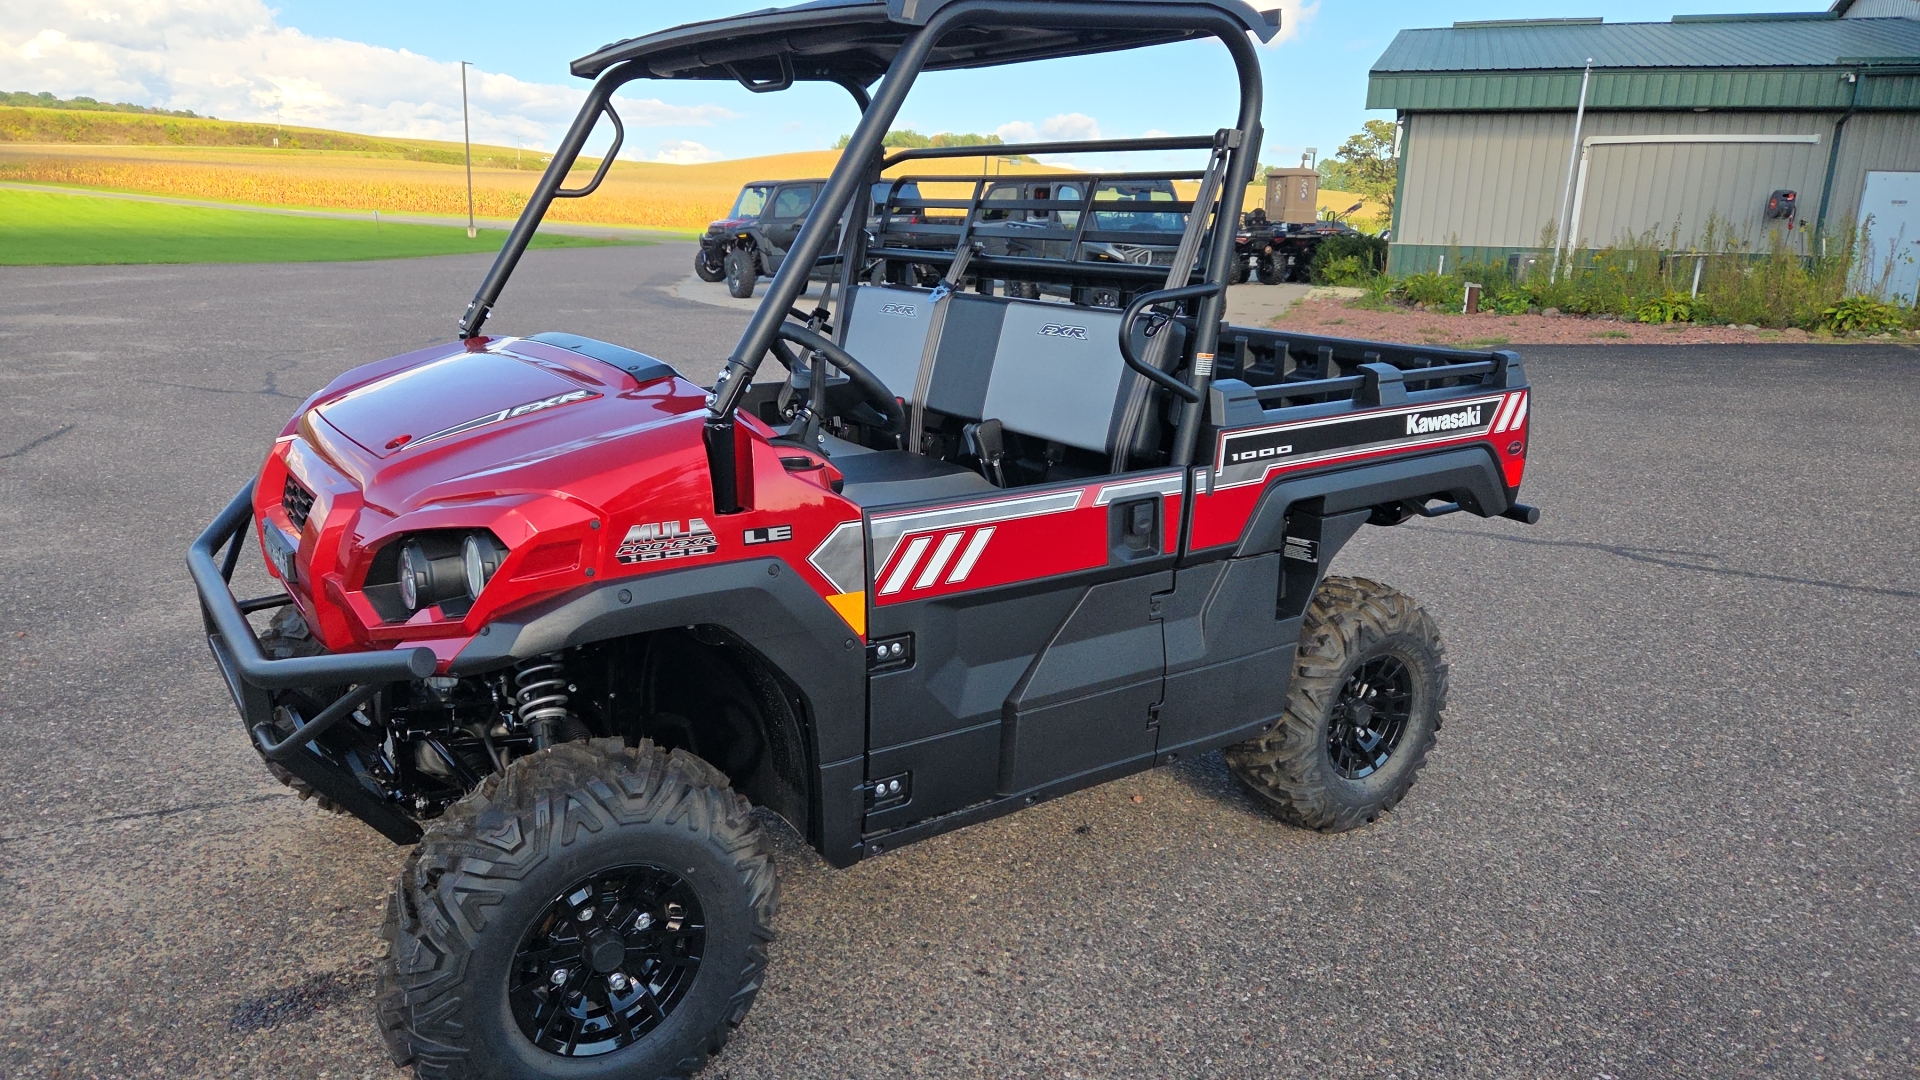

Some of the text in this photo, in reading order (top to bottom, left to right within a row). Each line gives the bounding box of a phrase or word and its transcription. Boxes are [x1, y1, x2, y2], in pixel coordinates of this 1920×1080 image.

[879, 302, 916, 317] FXR
[1037, 322, 1089, 341] FXR
[509, 389, 588, 416] FXR
[1405, 406, 1481, 435] Kawasaki
[1231, 444, 1293, 461] 1000
[621, 518, 713, 545] MULE
[744, 525, 792, 544] LE
[630, 546, 709, 562] 1000
